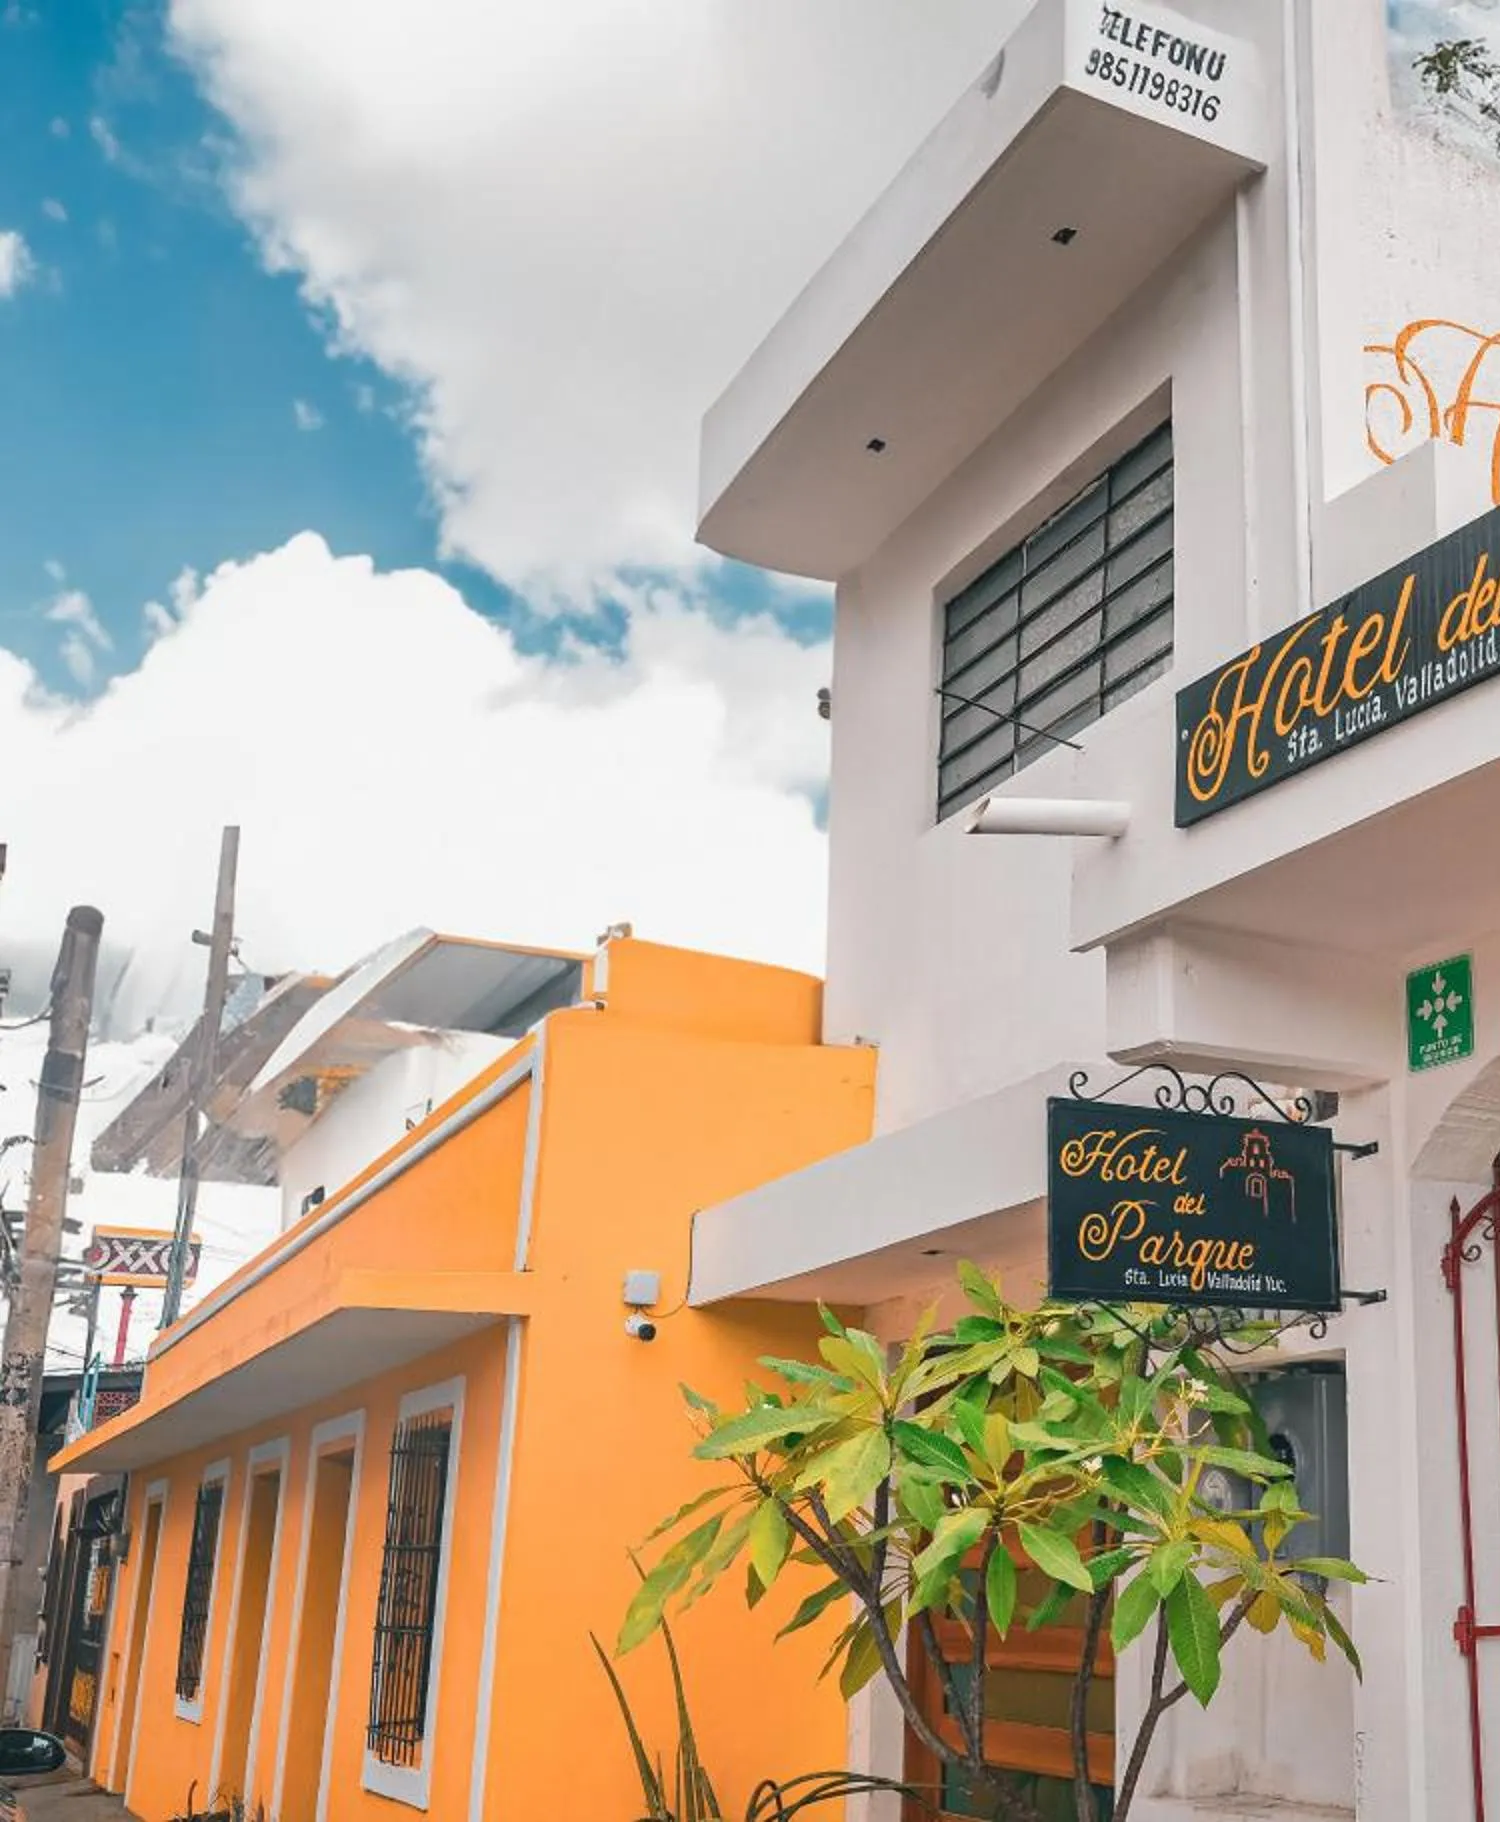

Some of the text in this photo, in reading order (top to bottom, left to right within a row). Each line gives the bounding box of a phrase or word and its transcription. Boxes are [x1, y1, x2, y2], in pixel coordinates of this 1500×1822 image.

[1085, 48, 1221, 122] 9851198316
[1187, 573, 1416, 801] Hotel
[1286, 724, 1323, 763] Sta.
[1060, 1128, 1189, 1185] Hotel
[1173, 1191, 1206, 1215] del
[1078, 1199, 1255, 1291] Parque
[1124, 1267, 1151, 1286] Sta.
[1265, 1274, 1288, 1293] Yuc.
